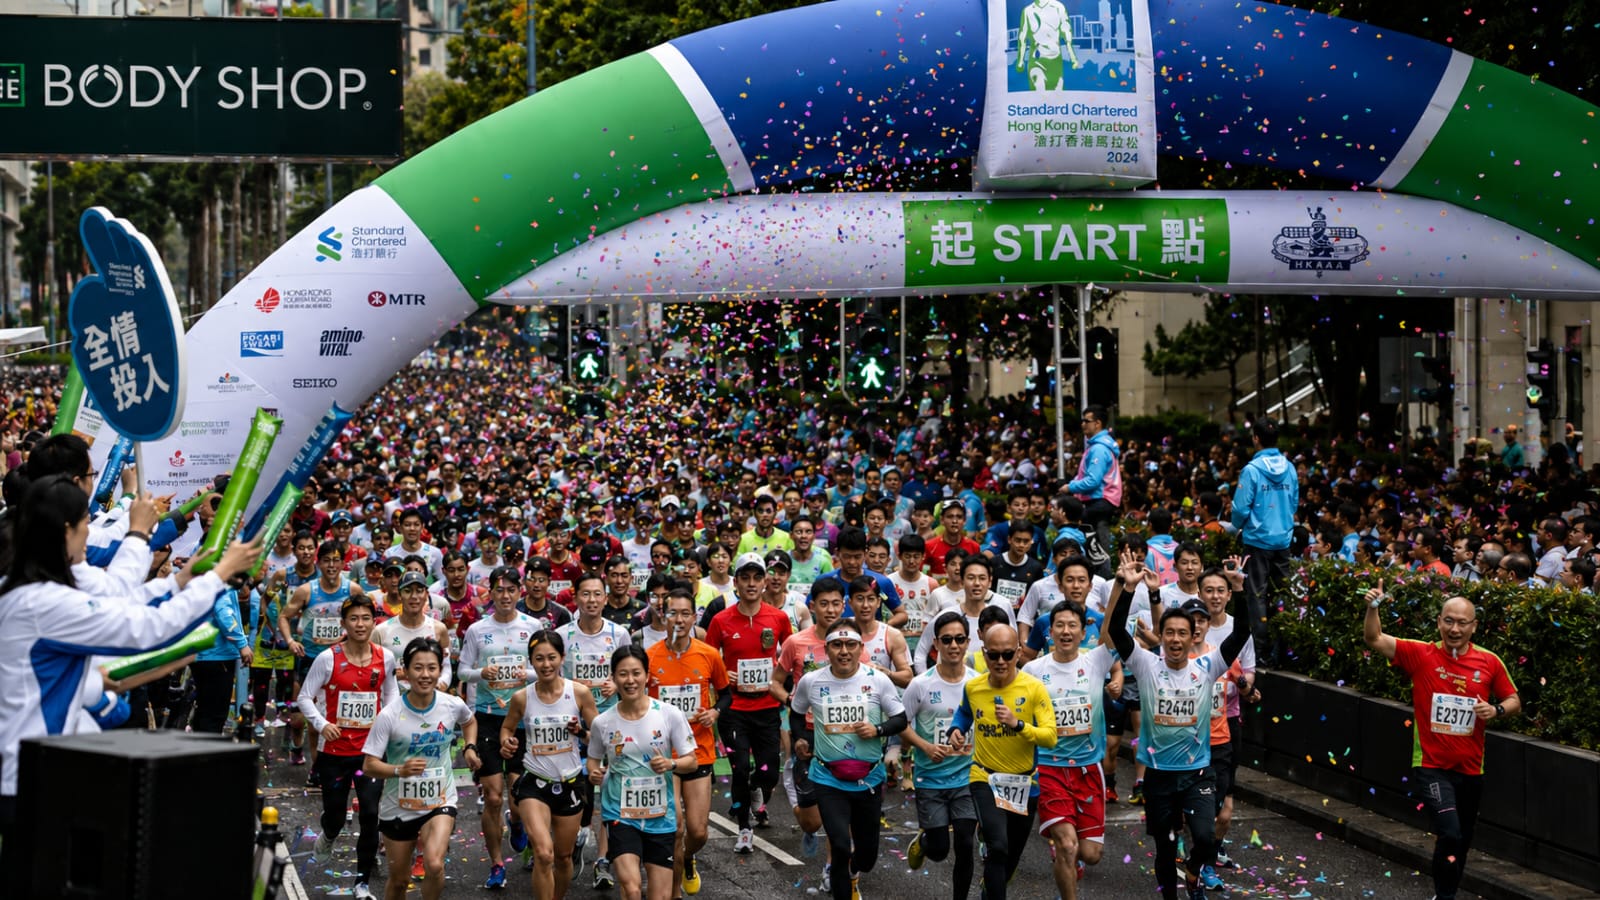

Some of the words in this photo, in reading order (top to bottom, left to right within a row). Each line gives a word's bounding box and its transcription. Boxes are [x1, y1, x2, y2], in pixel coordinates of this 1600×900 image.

[43, 63, 202, 108] BODY
[1007, 103, 1069, 117] Standard
[1072, 103, 1138, 117] Chartered
[1007, 120, 1041, 133] Hong
[1044, 119, 1078, 133] Kong
[1106, 151, 1138, 163] 2024
[352, 226, 404, 236] Standard
[351, 236, 407, 246] Chartered
[930, 219, 976, 267] 起
[992, 223, 1148, 262] START
[1160, 218, 1206, 265] 點
[1295, 261, 1343, 269] HKAAA
[389, 294, 426, 306] MTR
[83, 310, 140, 372] 全情
[320, 327, 363, 343] amino
[110, 353, 170, 412] 投入
[292, 378, 338, 389] SEIKO
[1158, 699, 1195, 716] E2440
[1435, 706, 1473, 726] E2377
[403, 780, 441, 798] F1681
[625, 789, 662, 807] E1651
